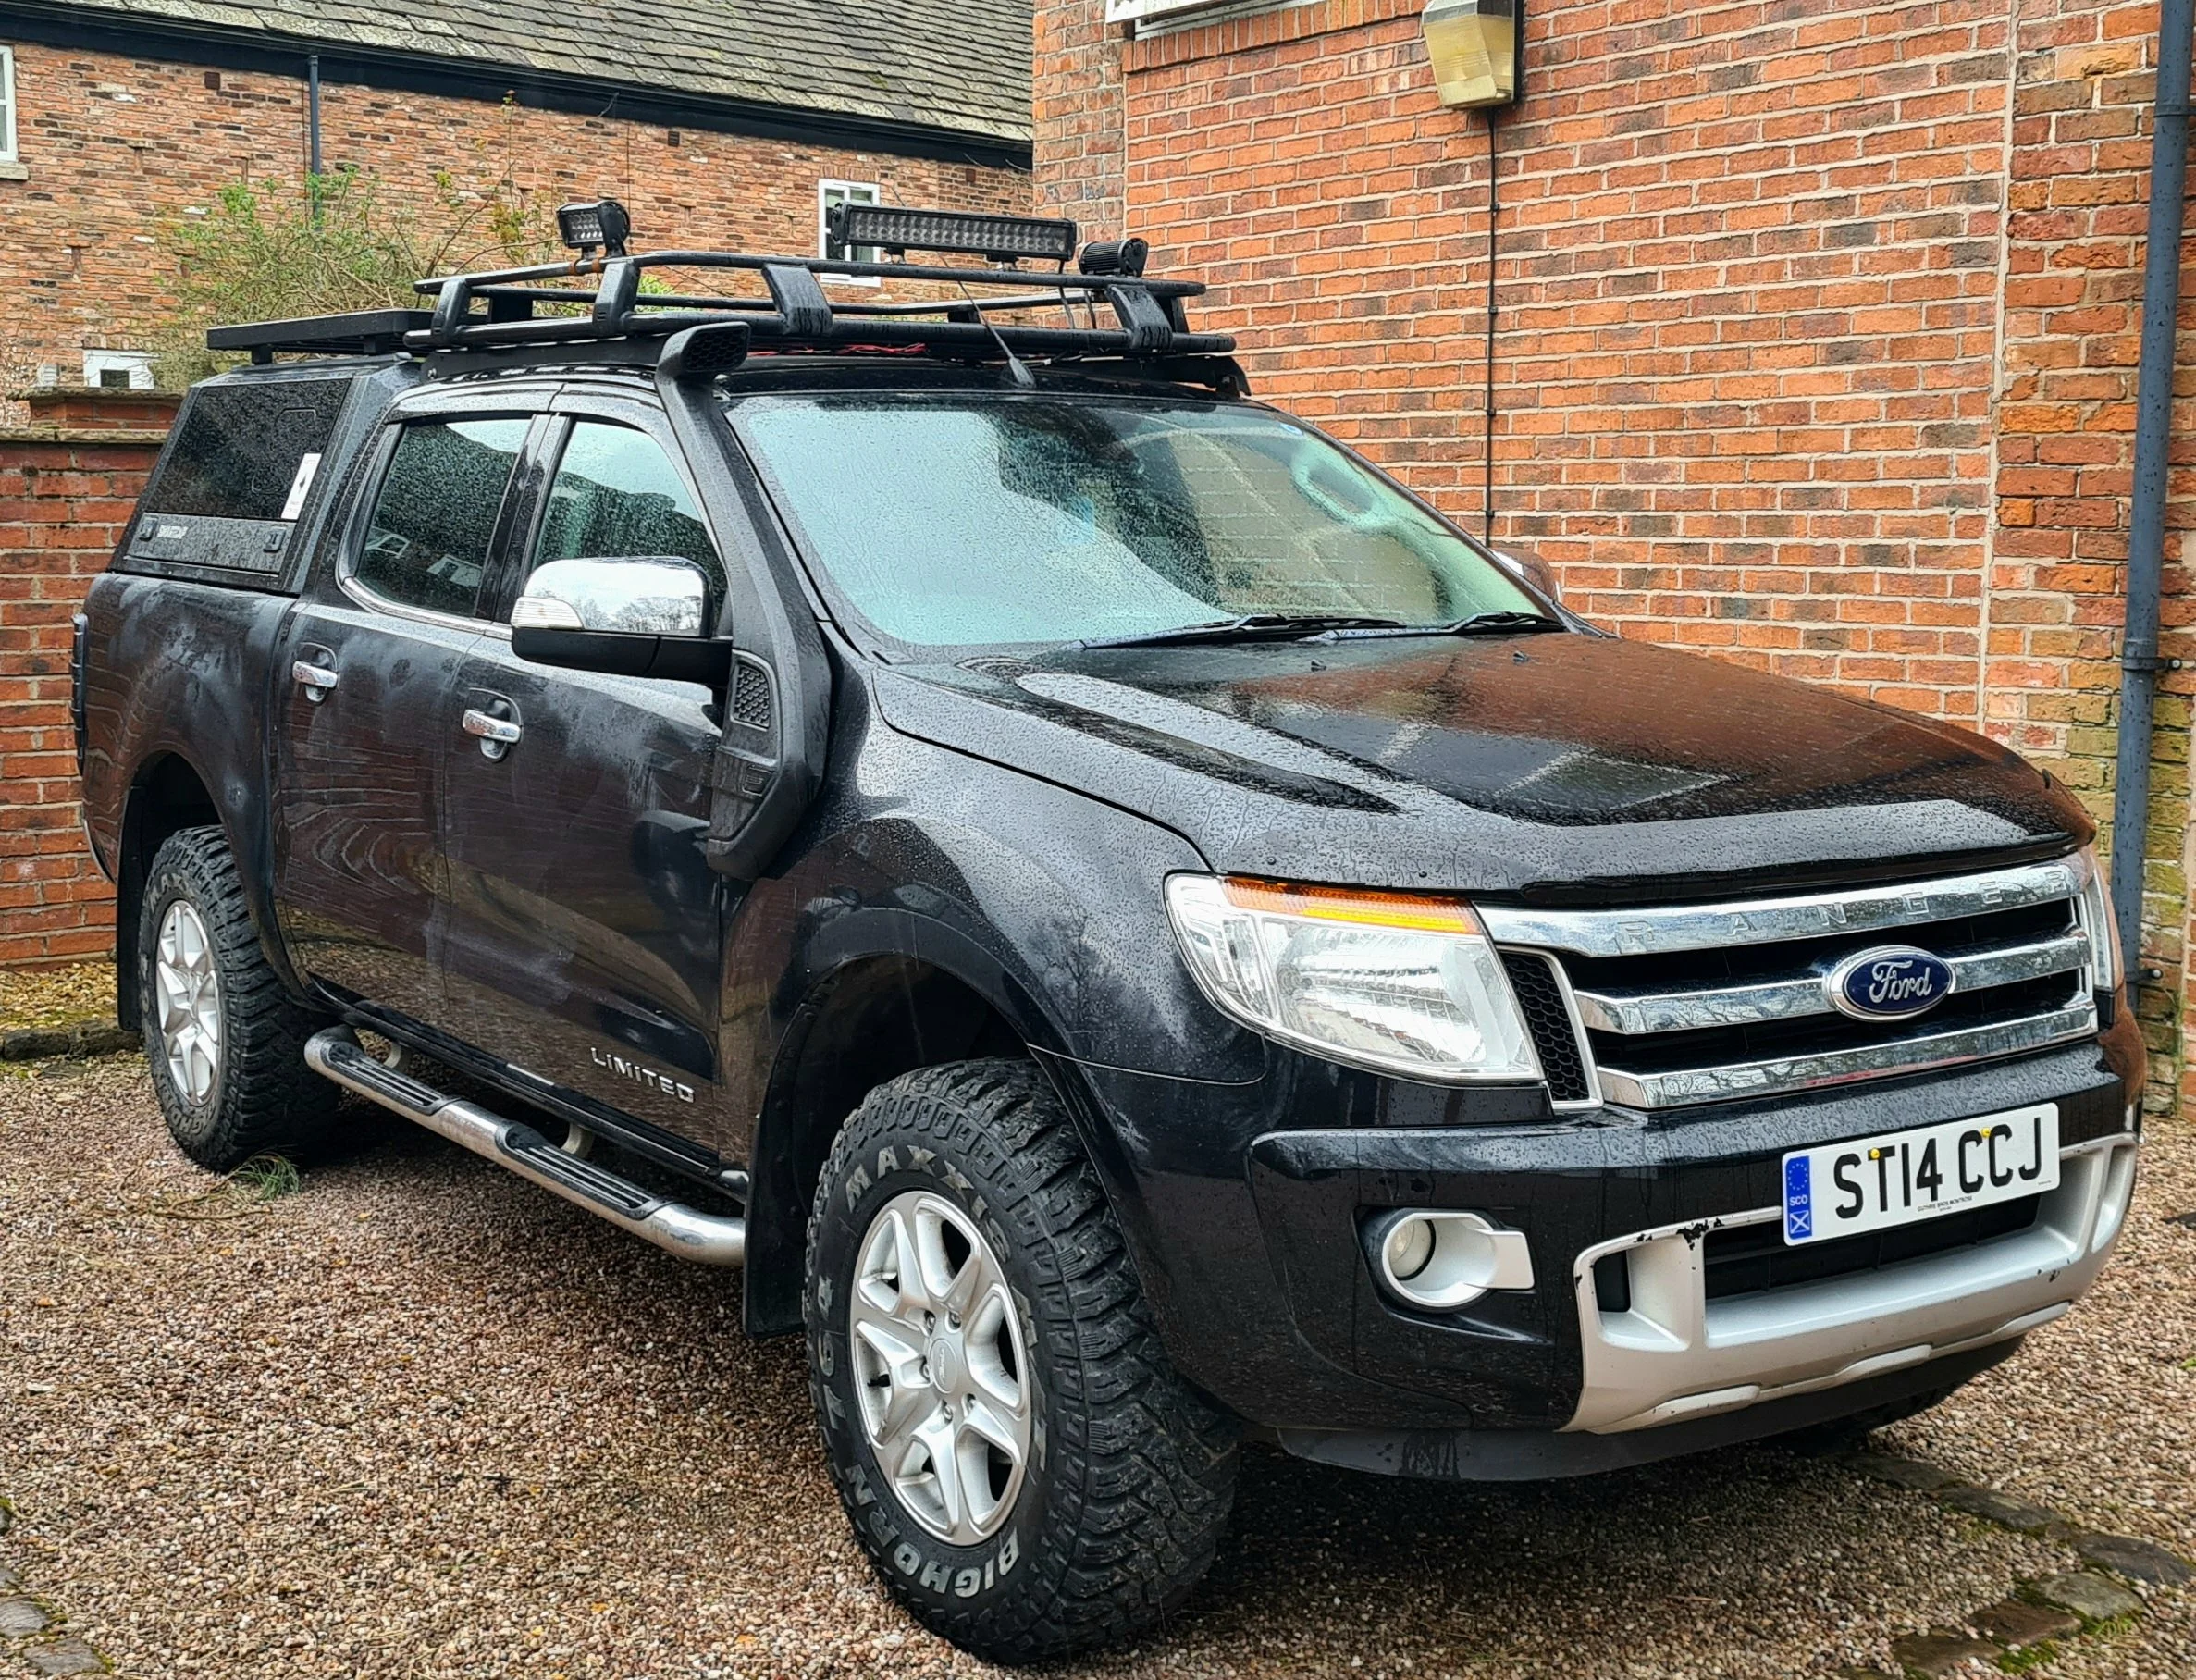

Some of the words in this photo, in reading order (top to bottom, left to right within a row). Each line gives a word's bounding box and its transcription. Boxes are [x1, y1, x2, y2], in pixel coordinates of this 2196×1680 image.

[1615, 871, 2069, 944] RANGER
[1869, 960, 1932, 1004] Ford
[590, 1046, 695, 1103] LIMITED
[845, 1144, 1012, 1265] MAXXIS
[1789, 1194, 1808, 1207] SCO
[1833, 1138, 1943, 1219] ST14
[1958, 1117, 2042, 1194] CCJ
[845, 1464, 1020, 1599] BIGHORN
